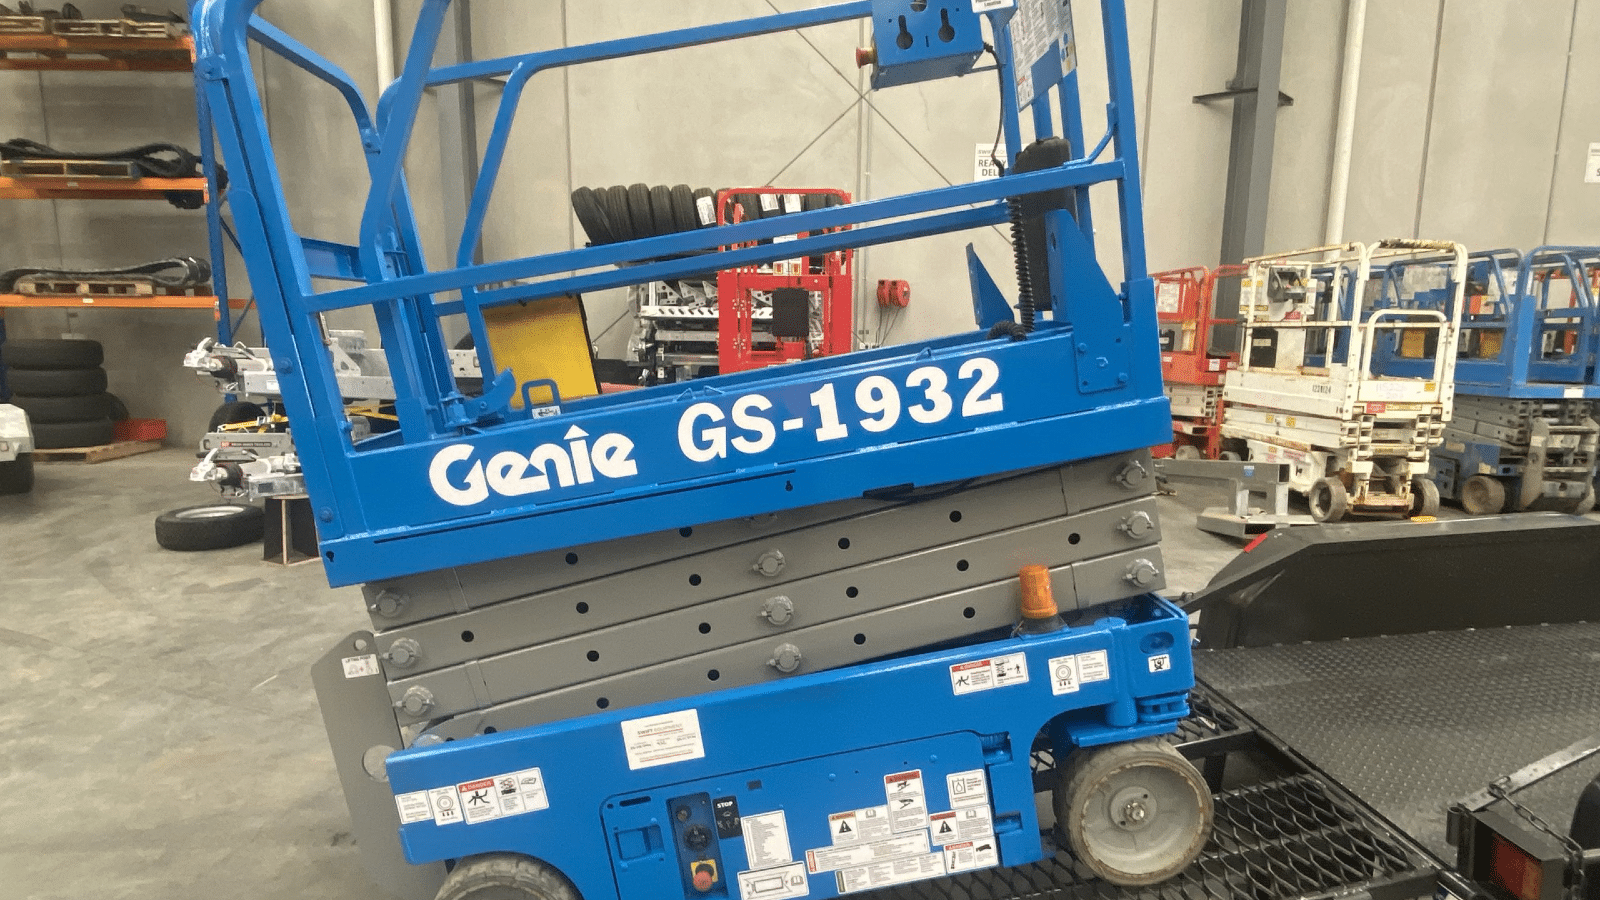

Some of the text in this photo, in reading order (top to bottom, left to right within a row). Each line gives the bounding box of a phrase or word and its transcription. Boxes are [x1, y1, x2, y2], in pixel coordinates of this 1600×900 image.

[978, 159, 1007, 167] REAY
[678, 358, 1003, 462] GS-1932
[428, 424, 638, 506] Genie
